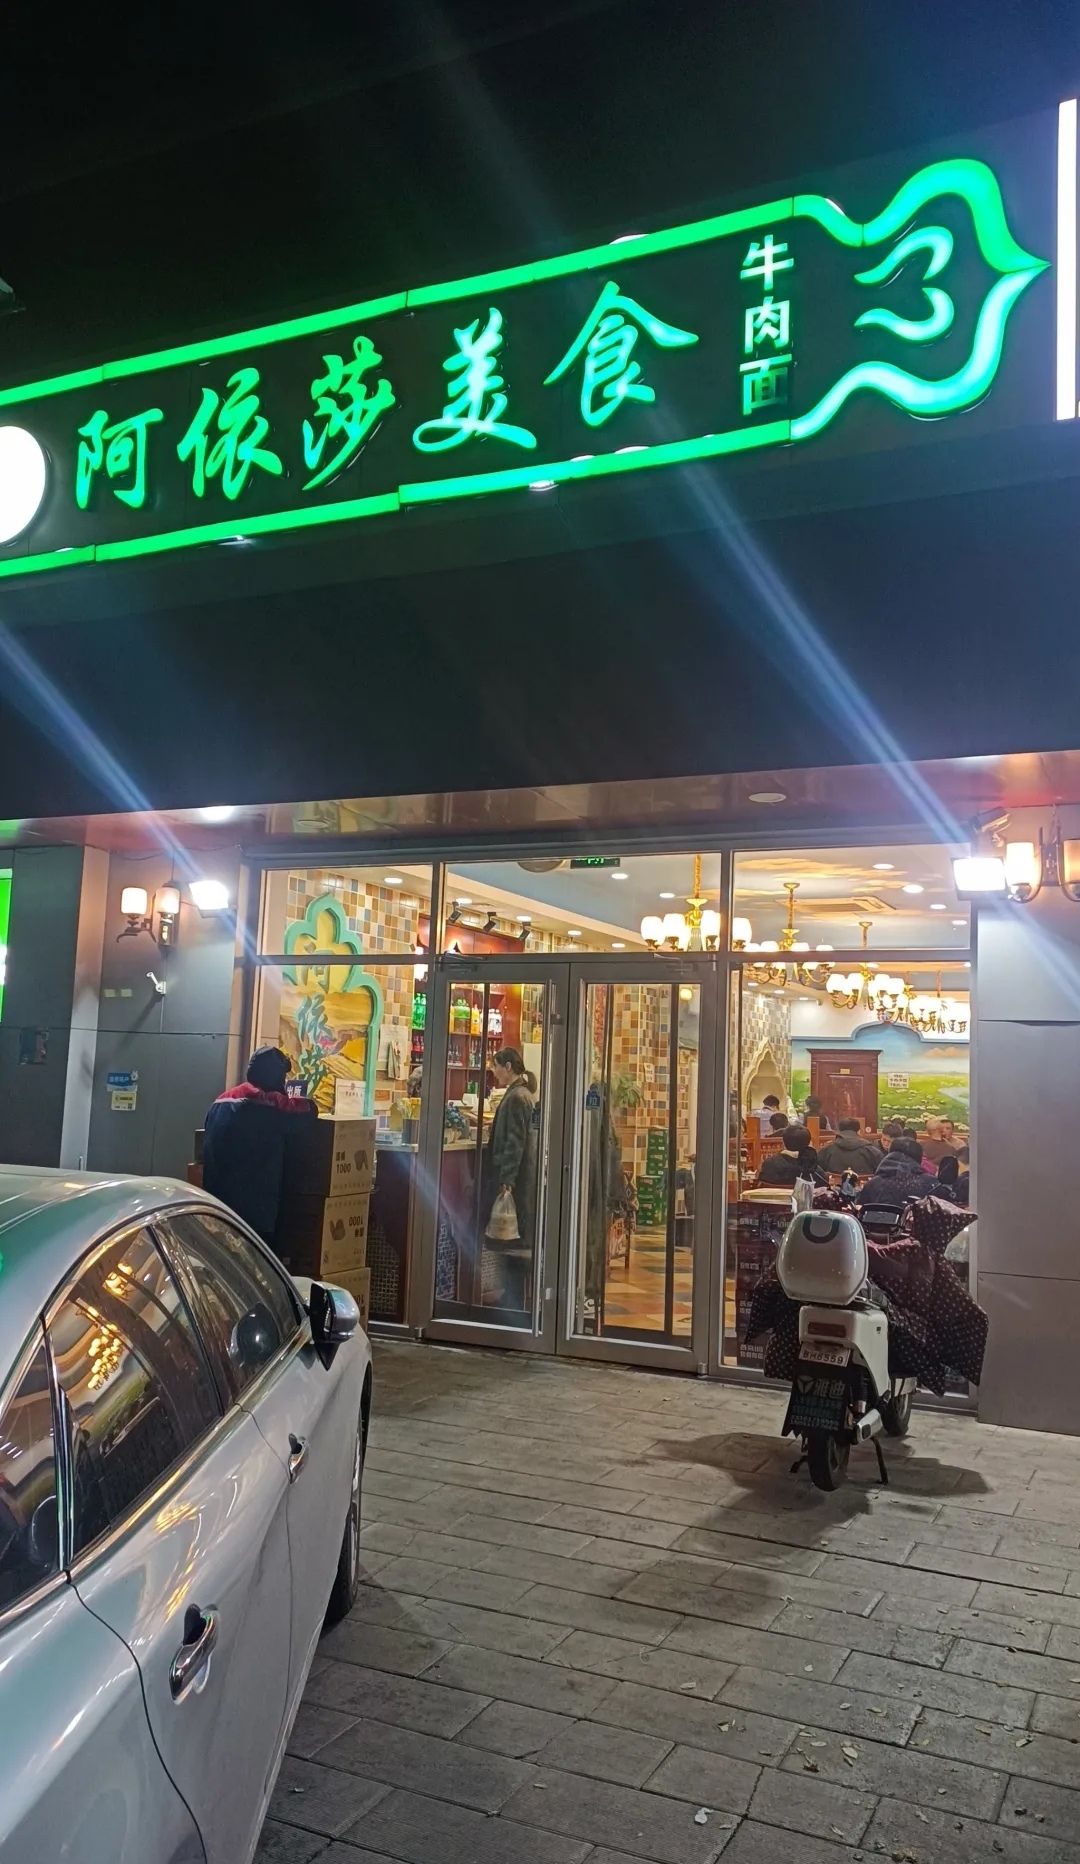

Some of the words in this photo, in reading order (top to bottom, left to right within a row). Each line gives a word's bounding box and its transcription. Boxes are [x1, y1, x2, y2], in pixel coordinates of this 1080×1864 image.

[75, 280, 699, 510] 阿依莎美食
[740, 235, 794, 416] 牛肉面
